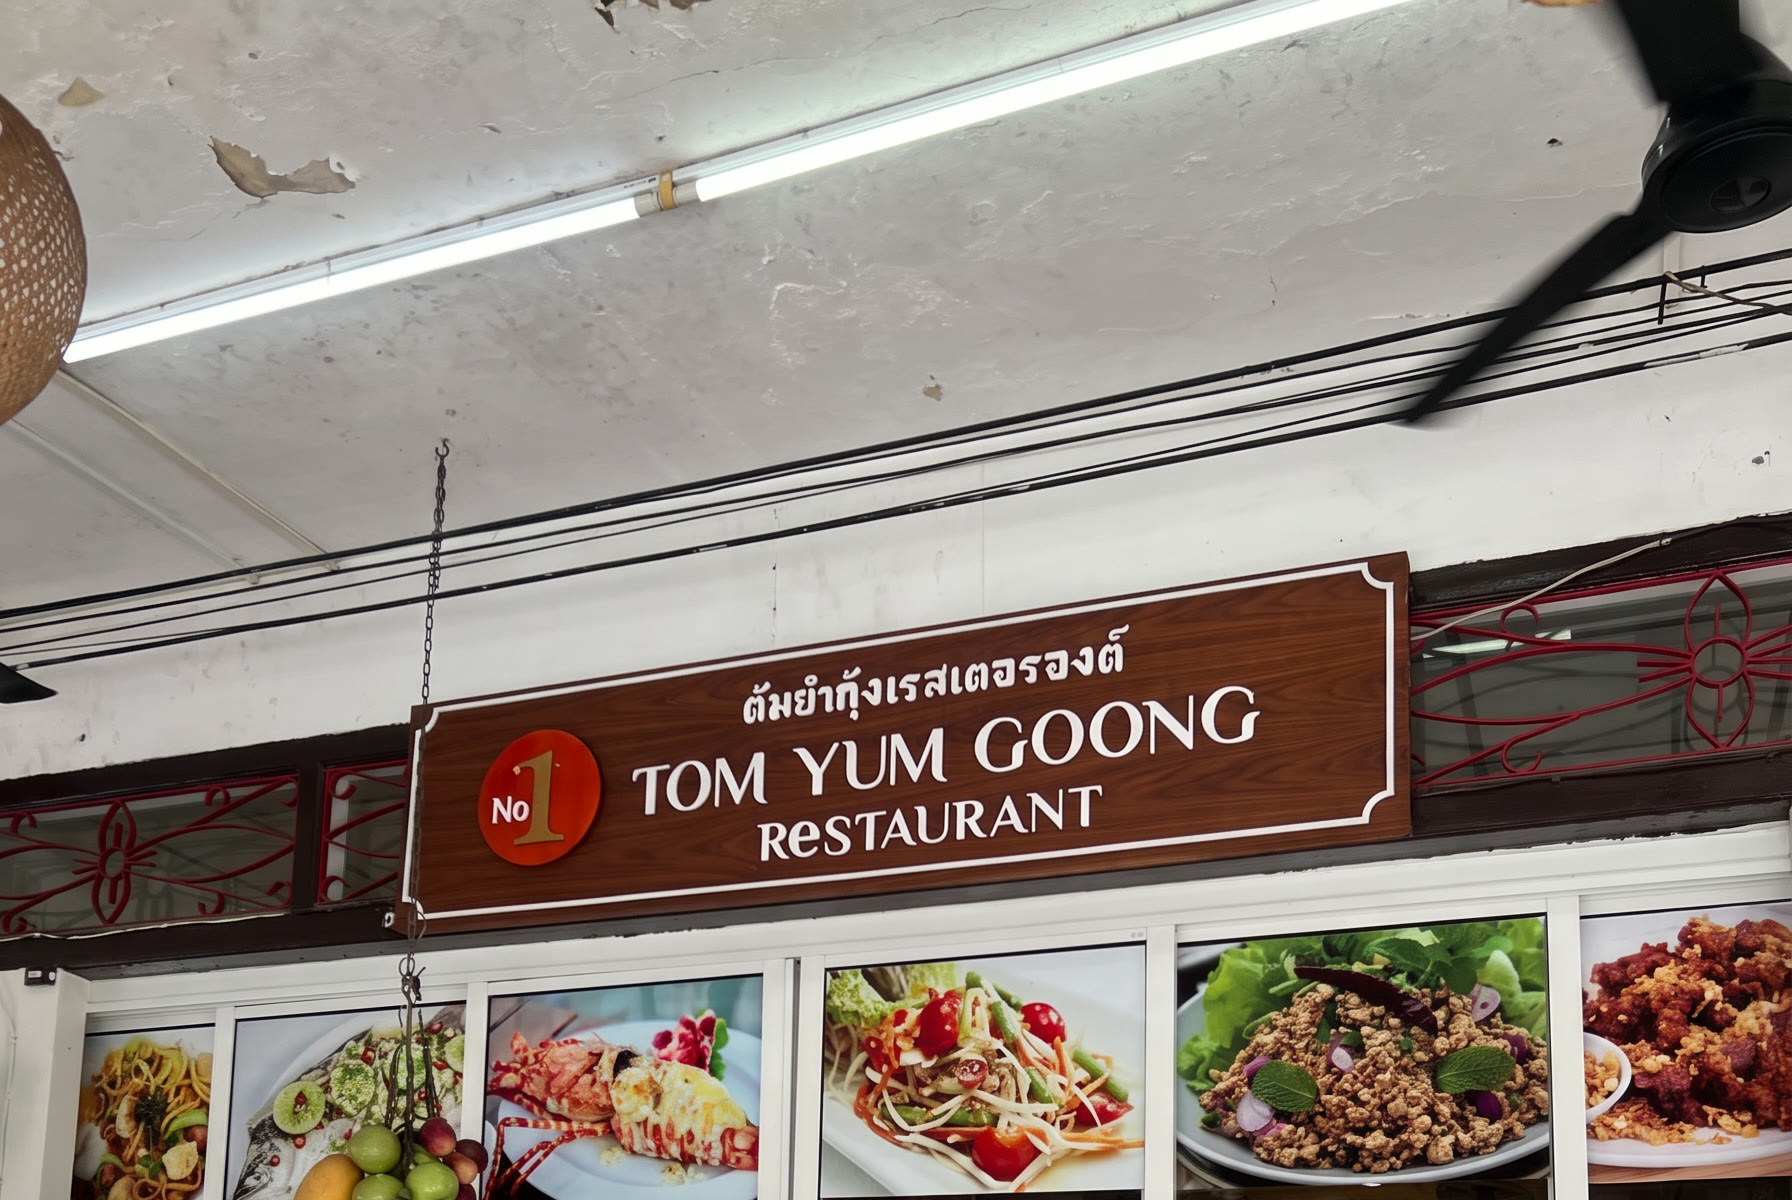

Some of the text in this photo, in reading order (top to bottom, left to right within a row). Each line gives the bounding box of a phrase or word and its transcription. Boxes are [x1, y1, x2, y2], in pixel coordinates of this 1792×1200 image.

[742, 623, 1130, 724] ต้มยำกุ้งเรสเตอรองต์
[491, 750, 564, 846] No 1
[631, 685, 1261, 815] TOM YUM GOONG
